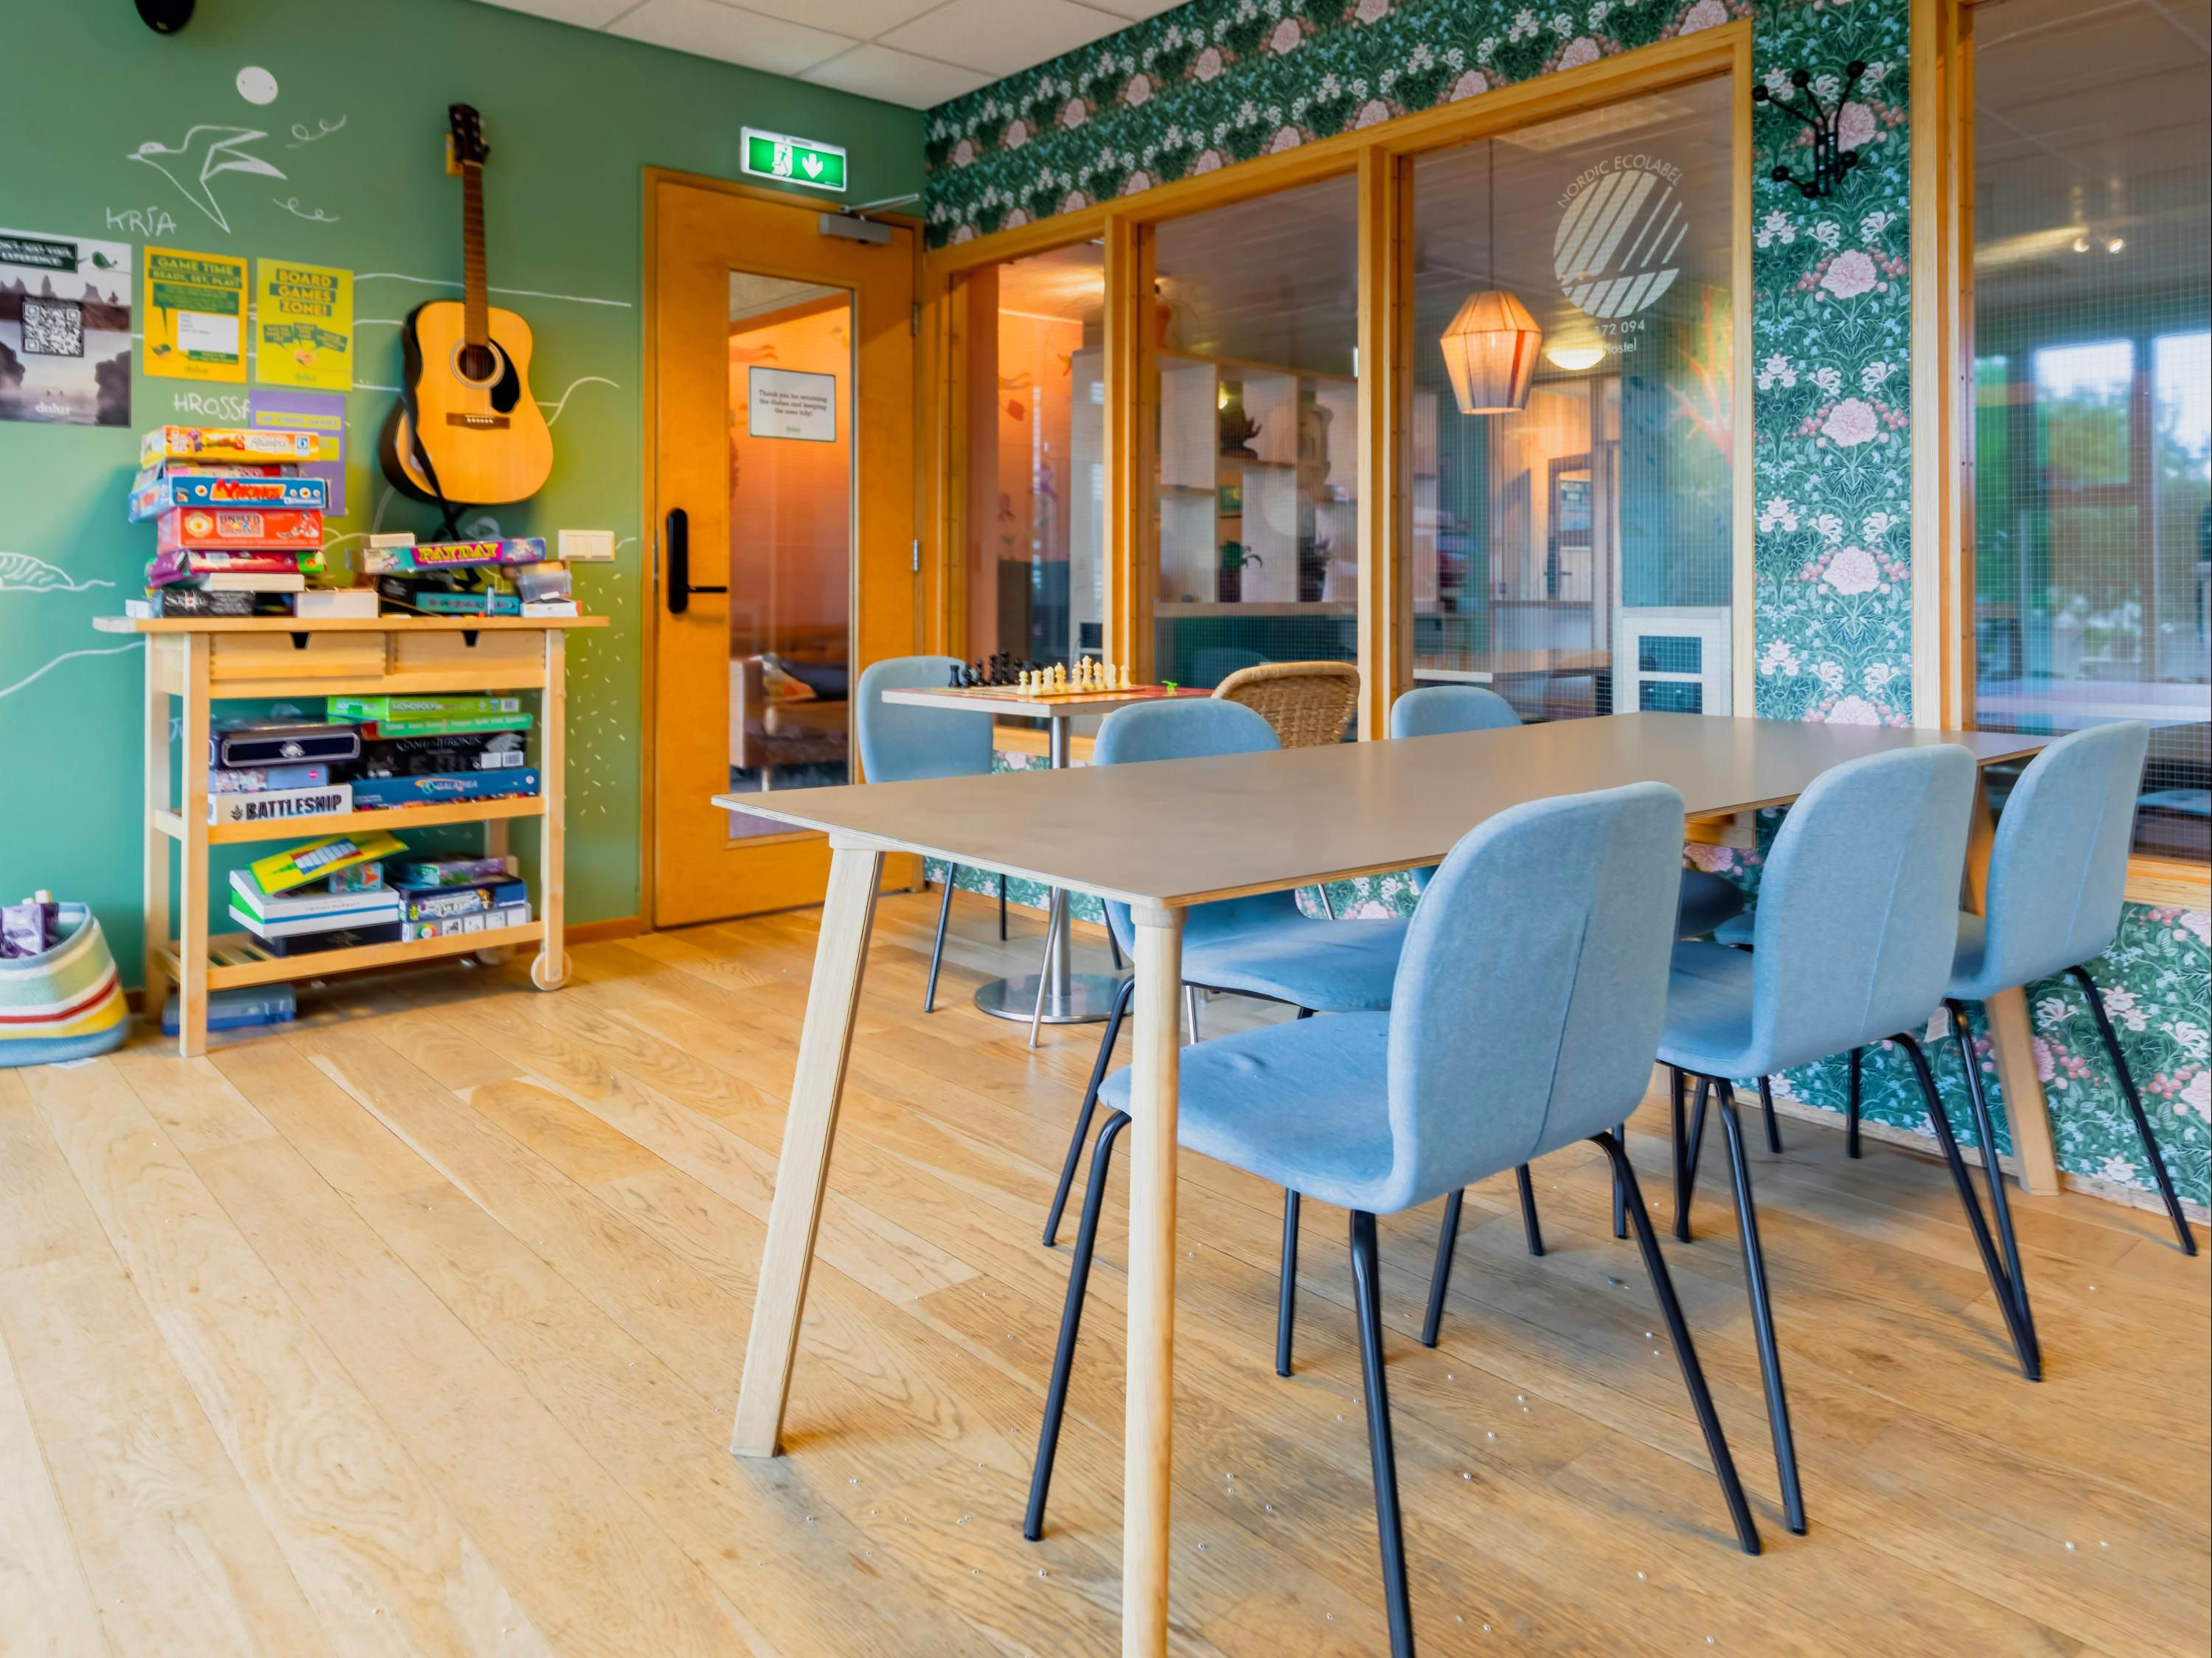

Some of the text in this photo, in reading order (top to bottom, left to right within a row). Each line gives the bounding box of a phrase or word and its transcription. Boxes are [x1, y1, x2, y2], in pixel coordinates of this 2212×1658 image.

[1557, 153, 1683, 209] NORDIC ECOLABEL
[158, 257, 234, 276] GAME TIME
[153, 270, 189, 283] READY,
[191, 274, 208, 284] SET,
[278, 270, 332, 287] BOARD
[278, 285, 332, 303] GAMES
[281, 300, 328, 316] ZONE!
[1620, 319, 1646, 333] 094
[759, 389, 778, 397] Thank
[35, 402, 72, 415] dalur
[392, 701, 437, 711] MONOPOLY
[246, 794, 342, 821] BATTLESHIP
